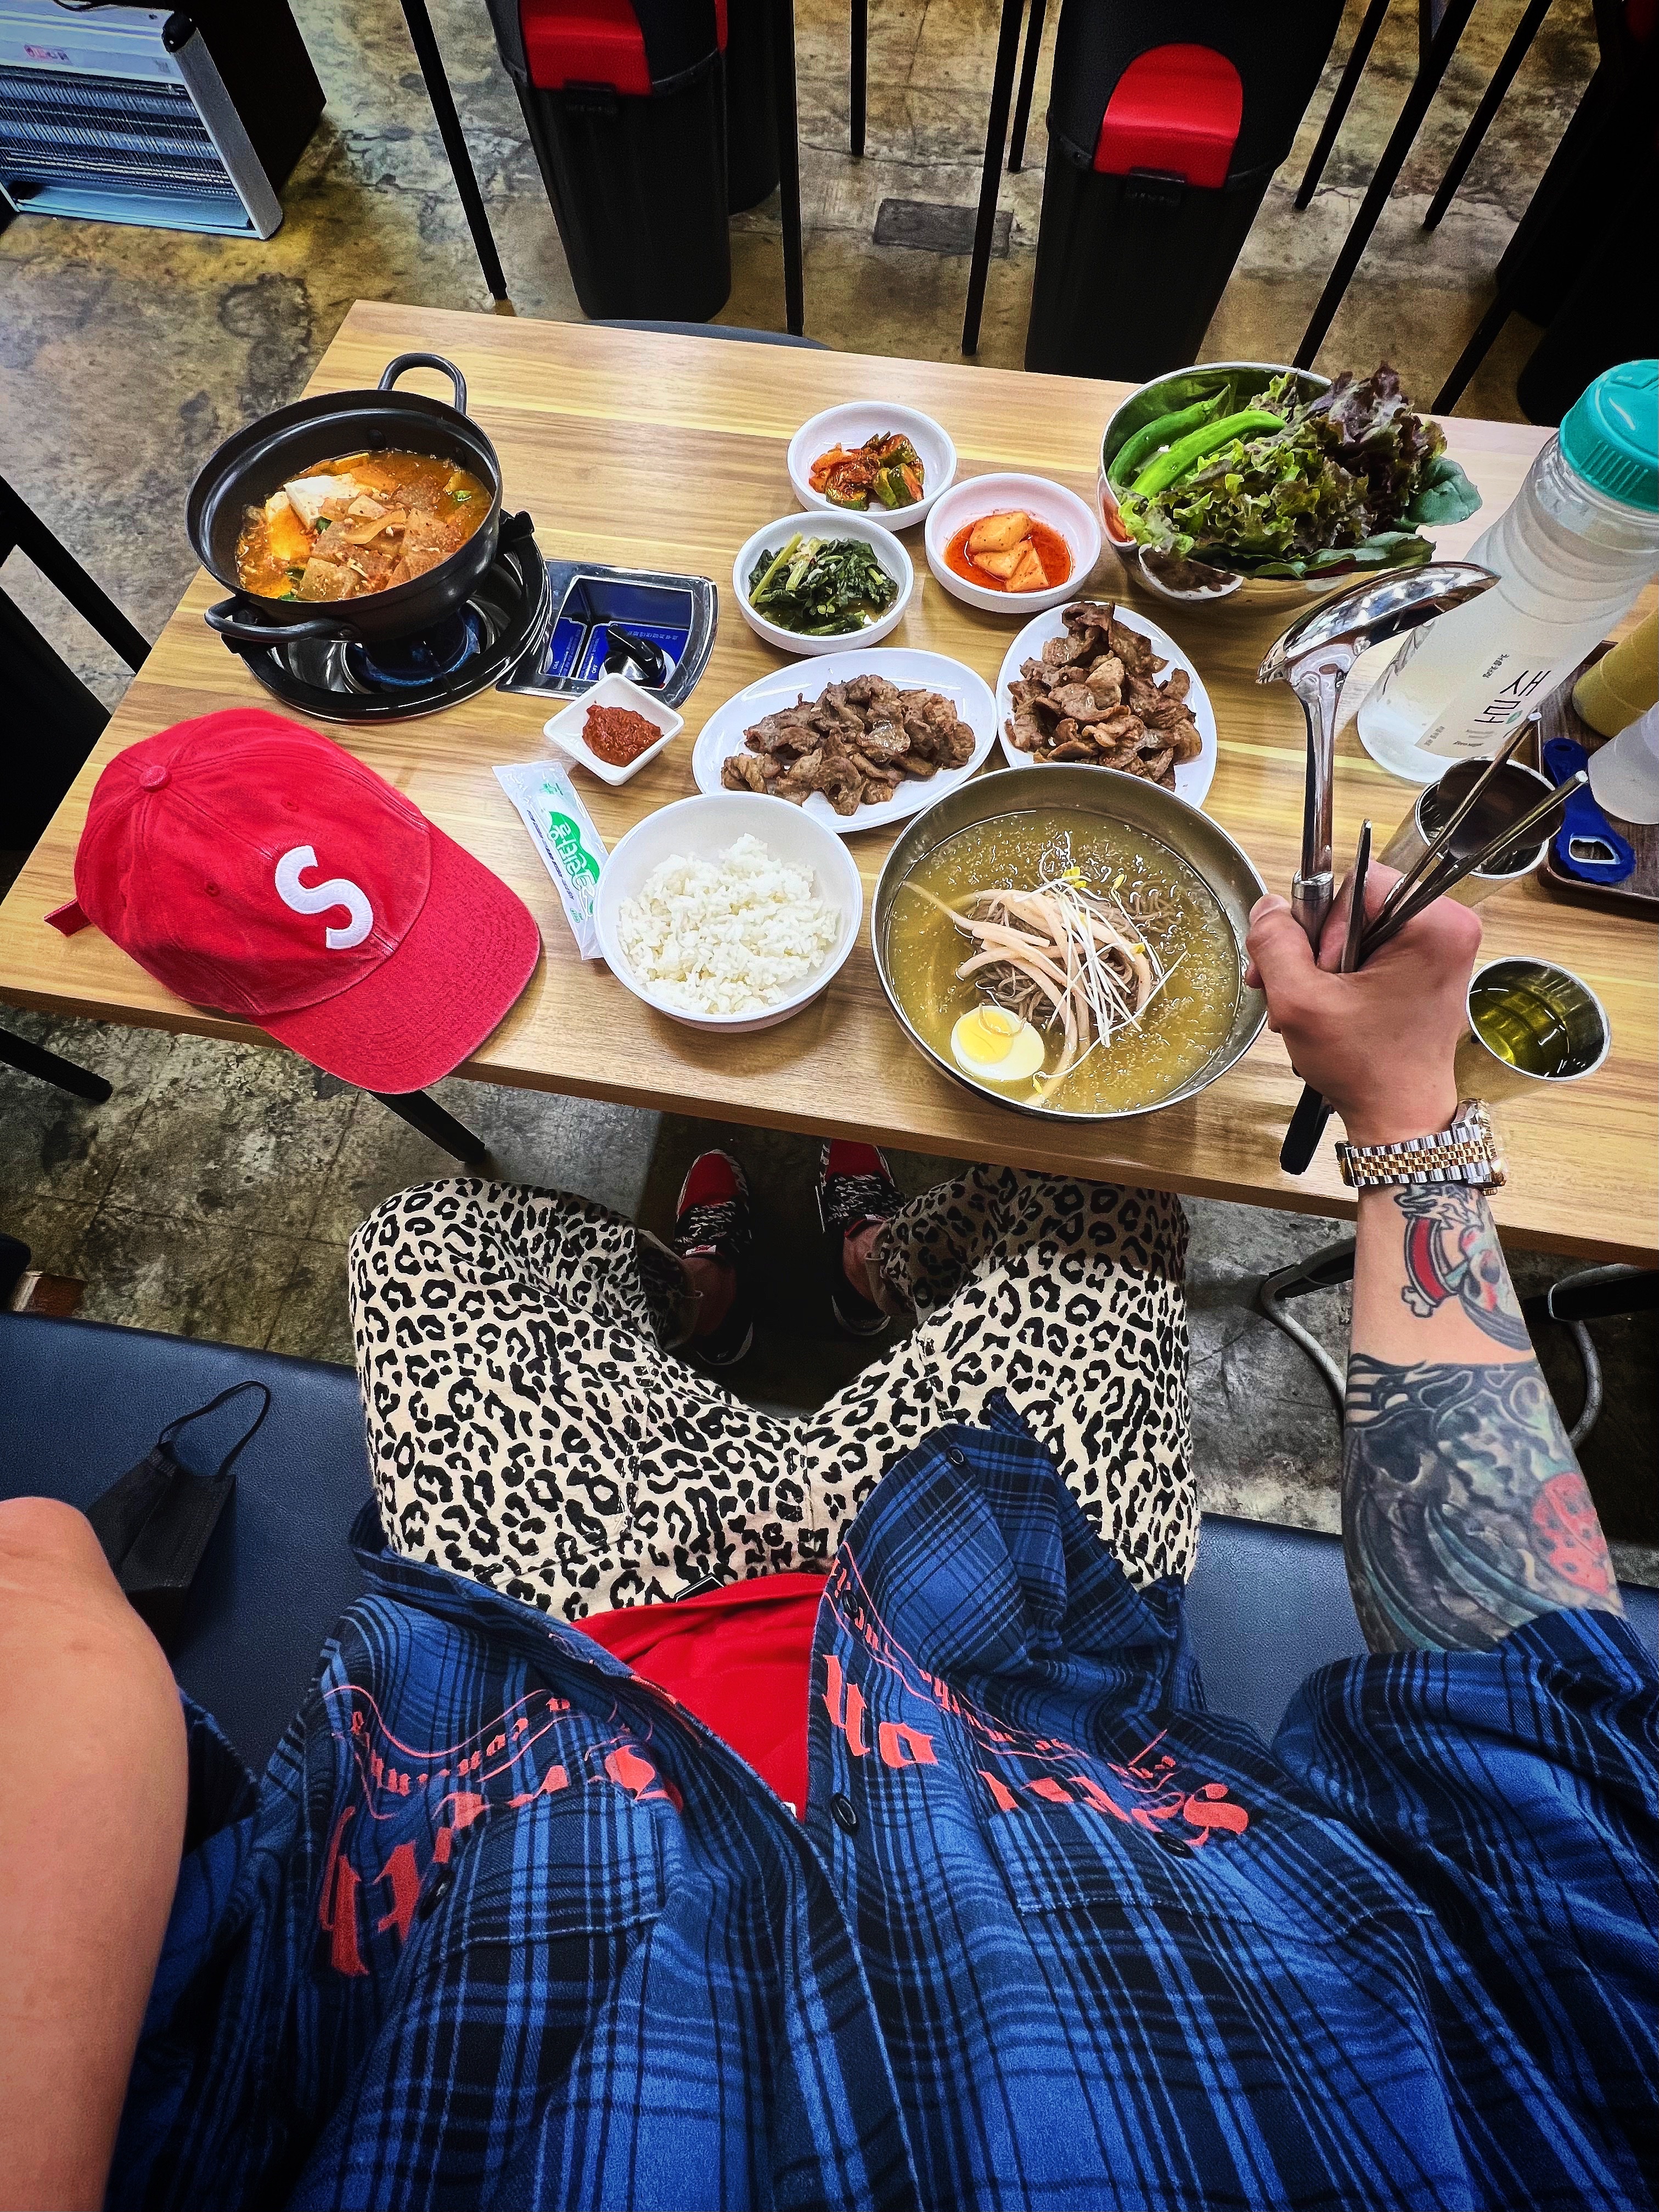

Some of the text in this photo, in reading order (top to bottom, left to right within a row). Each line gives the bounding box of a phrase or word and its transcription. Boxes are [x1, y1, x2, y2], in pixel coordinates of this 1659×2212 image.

[1474, 670, 1551, 723] 새로
[549, 821, 597, 891] 크린타올
[275, 845, 373, 949] S
